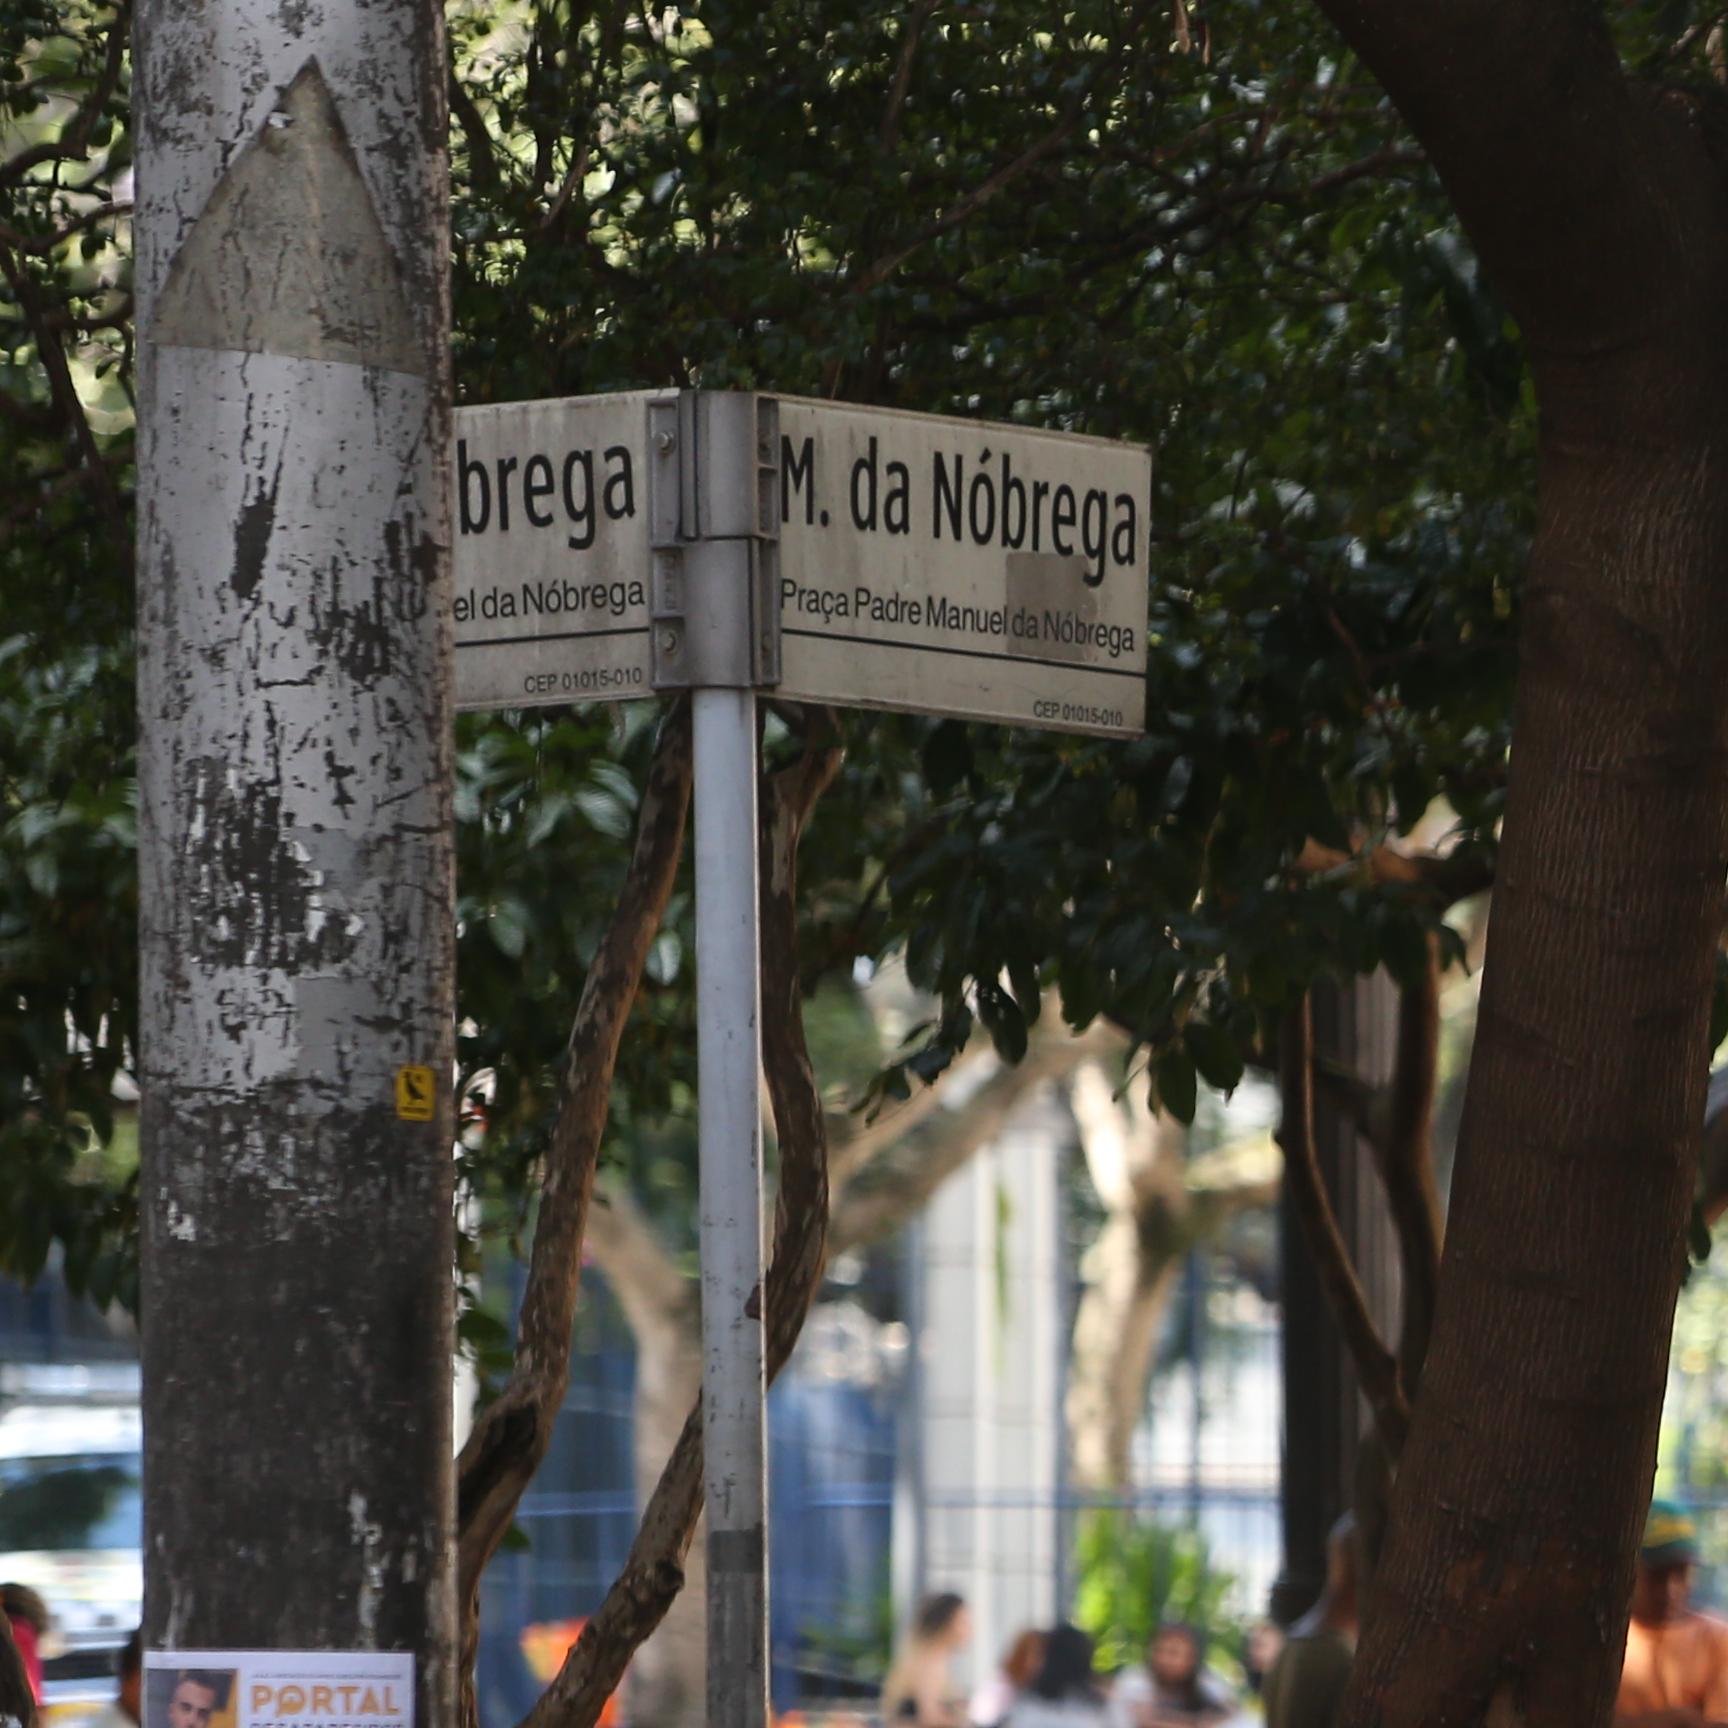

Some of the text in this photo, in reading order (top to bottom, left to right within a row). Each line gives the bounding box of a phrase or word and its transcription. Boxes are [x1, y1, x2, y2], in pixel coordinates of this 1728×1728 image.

[457, 438, 636, 550] brega
[780, 434, 1137, 588] M. da Nóbrega
[481, 586, 517, 620] da
[522, 579, 646, 617] Nóbrega
[780, 577, 1135, 658] Praça Padre Manuel da Nóbrega
[523, 667, 643, 694] CEP 01015-010
[1033, 700, 1124, 728] CEP 01015-010
[251, 1684, 401, 1718] PORTAL
